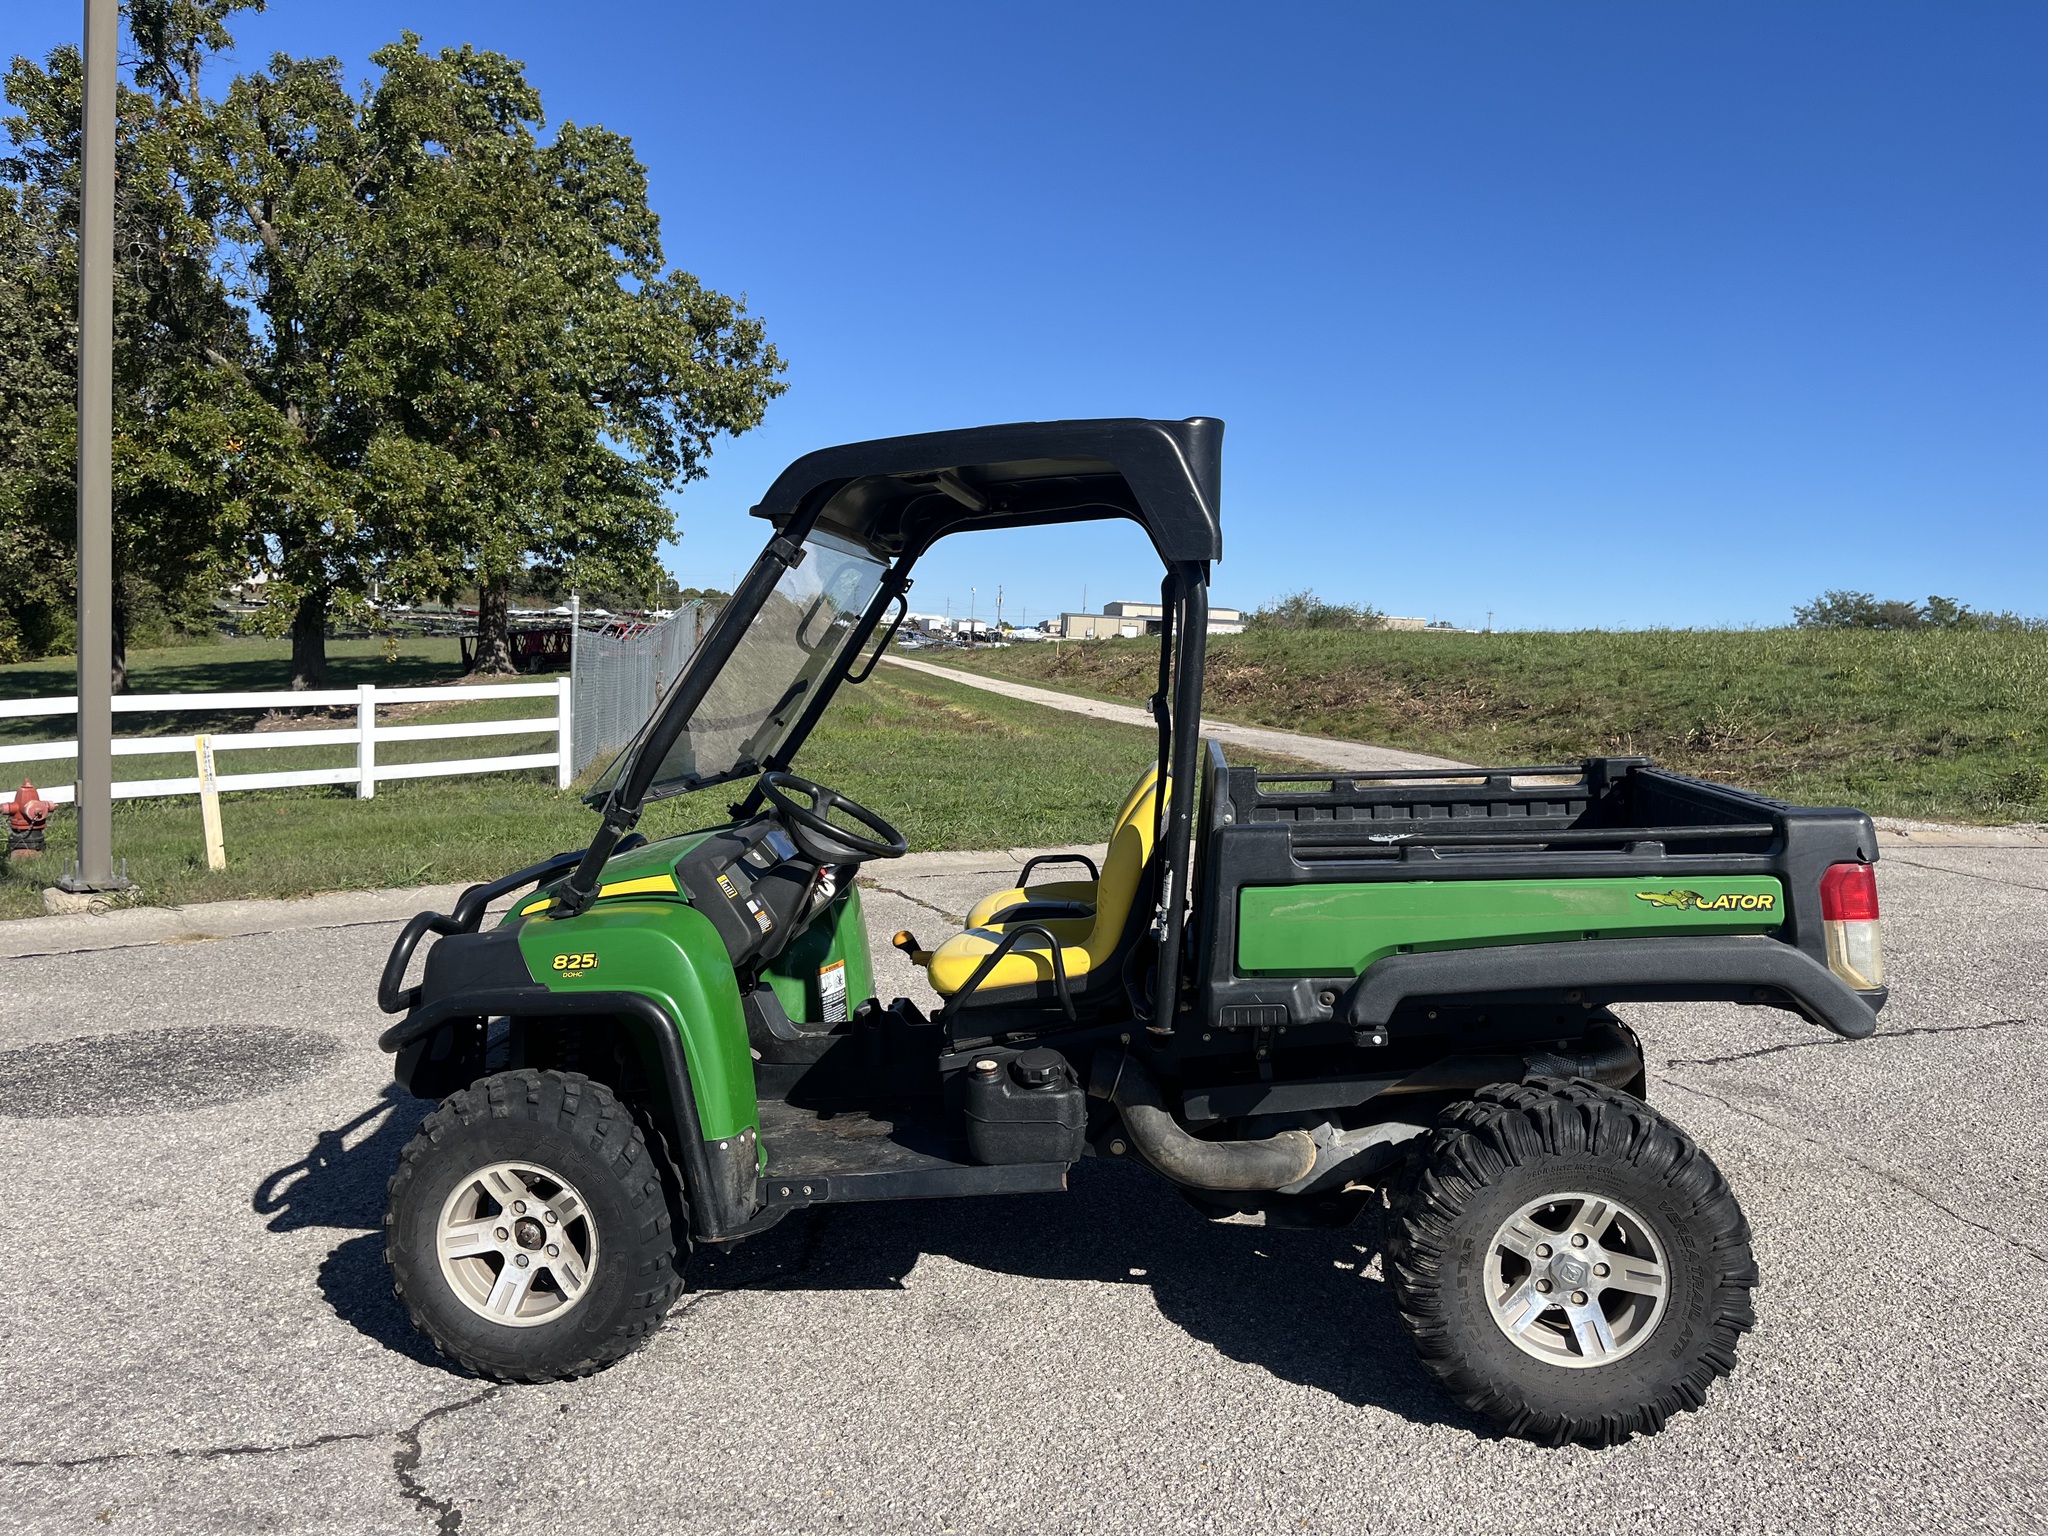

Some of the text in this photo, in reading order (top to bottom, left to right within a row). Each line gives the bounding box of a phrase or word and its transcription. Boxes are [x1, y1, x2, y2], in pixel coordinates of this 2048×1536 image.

[1695, 894, 1775, 910] GATOR
[552, 953, 598, 970] 825i
[1657, 1200, 1705, 1359] VERSA TRAIL ATR
